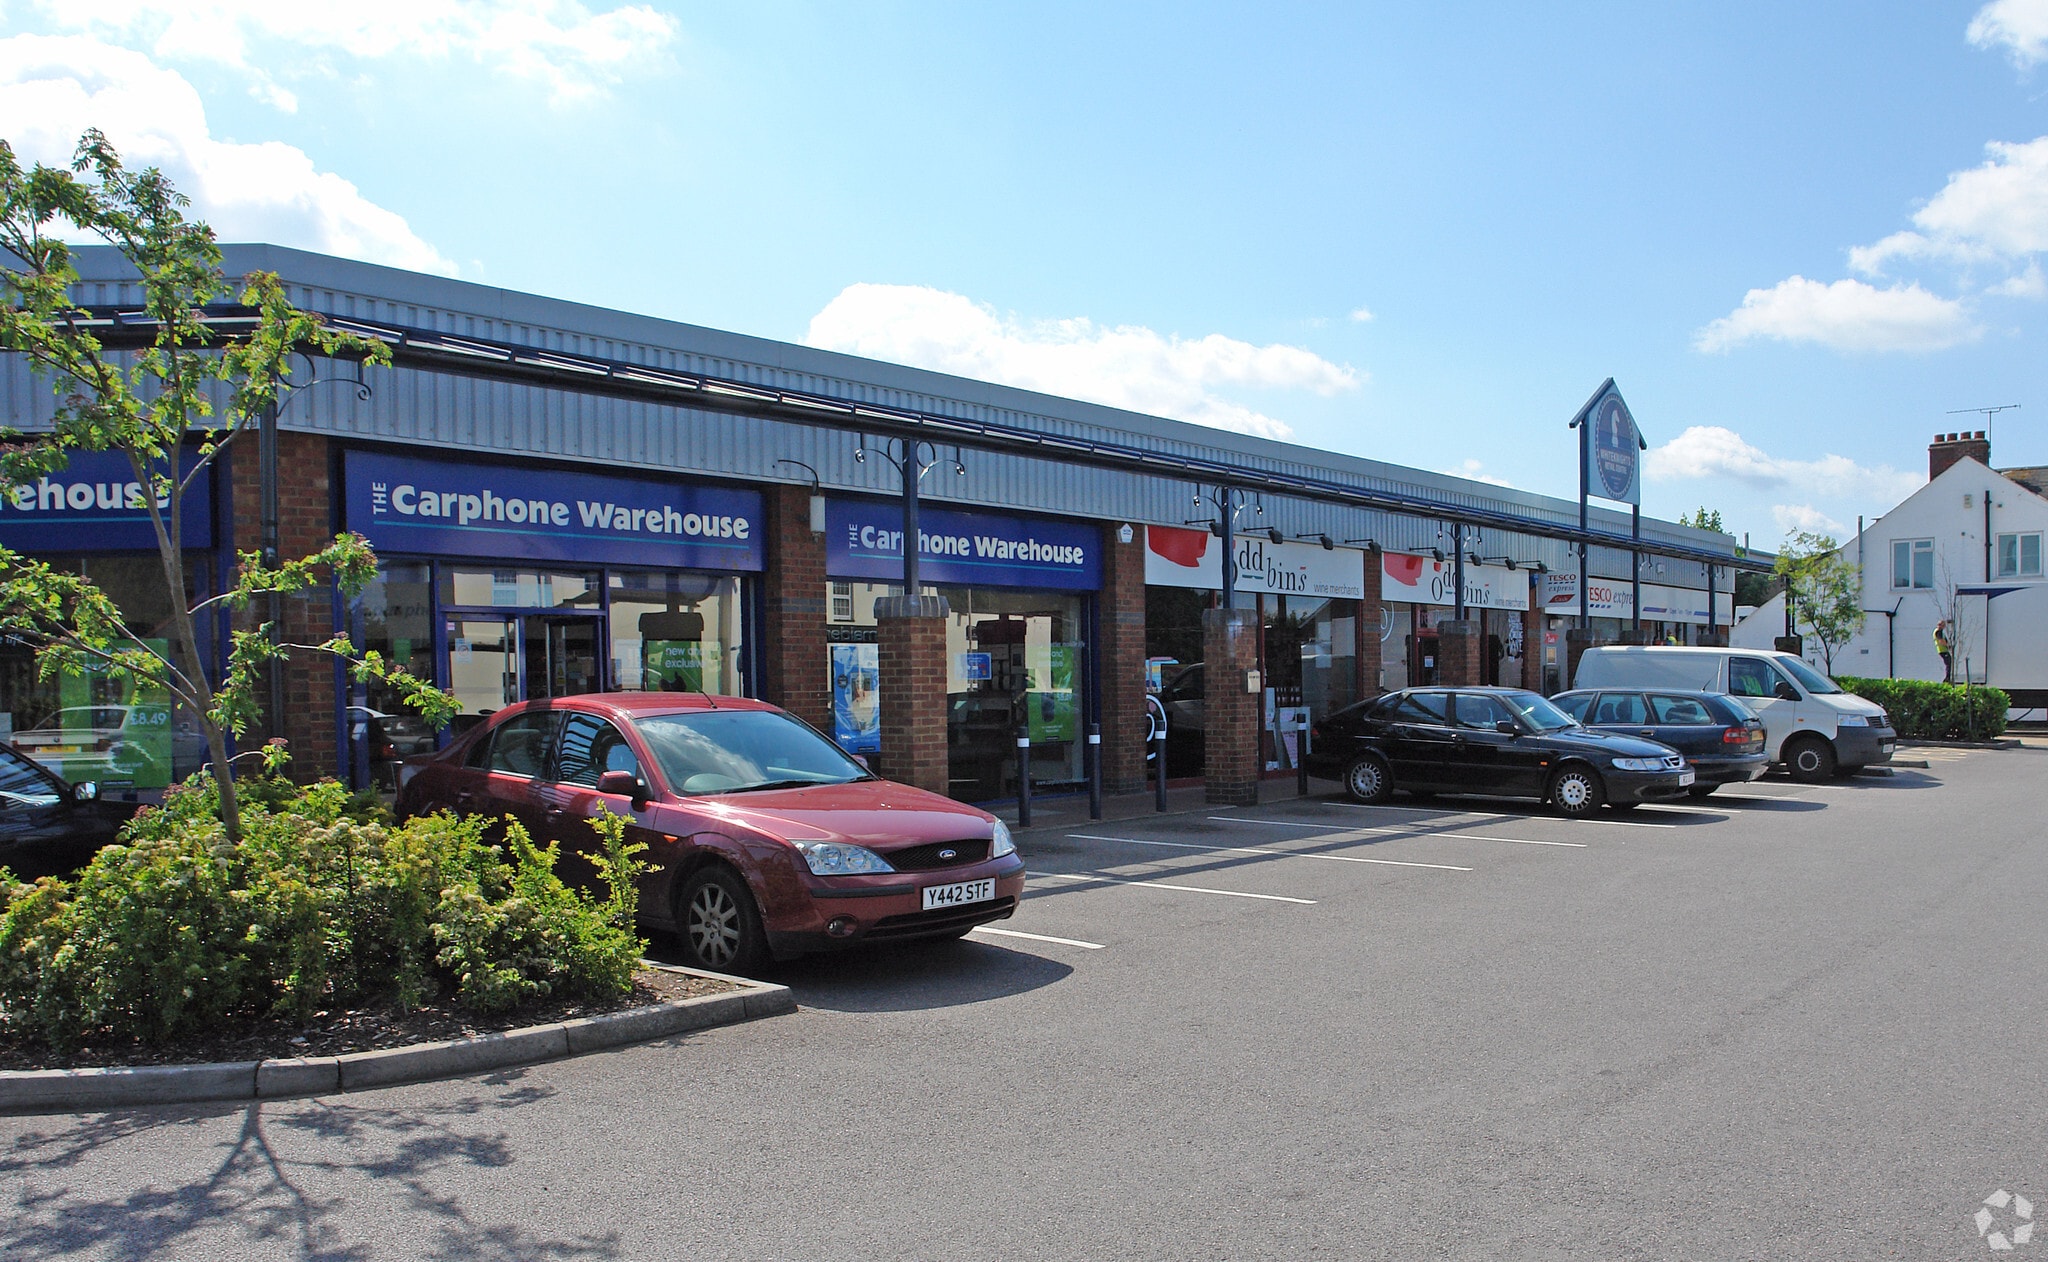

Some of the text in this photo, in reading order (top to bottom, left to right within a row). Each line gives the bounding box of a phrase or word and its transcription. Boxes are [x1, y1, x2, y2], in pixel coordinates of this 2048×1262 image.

[373, 482, 749, 539] THE Carphone Warehouse
[849, 523, 858, 549] THE
[974, 535, 1084, 565] Warehouse
[1548, 574, 1576, 582] TESCO
[1314, 583, 1360, 596] wine merchants
[1548, 585, 1575, 593] express
[1587, 586, 1611, 602] ESCO
[665, 647, 685, 656] new
[129, 712, 167, 726] £8.49
[929, 882, 990, 905] Y442 STF
